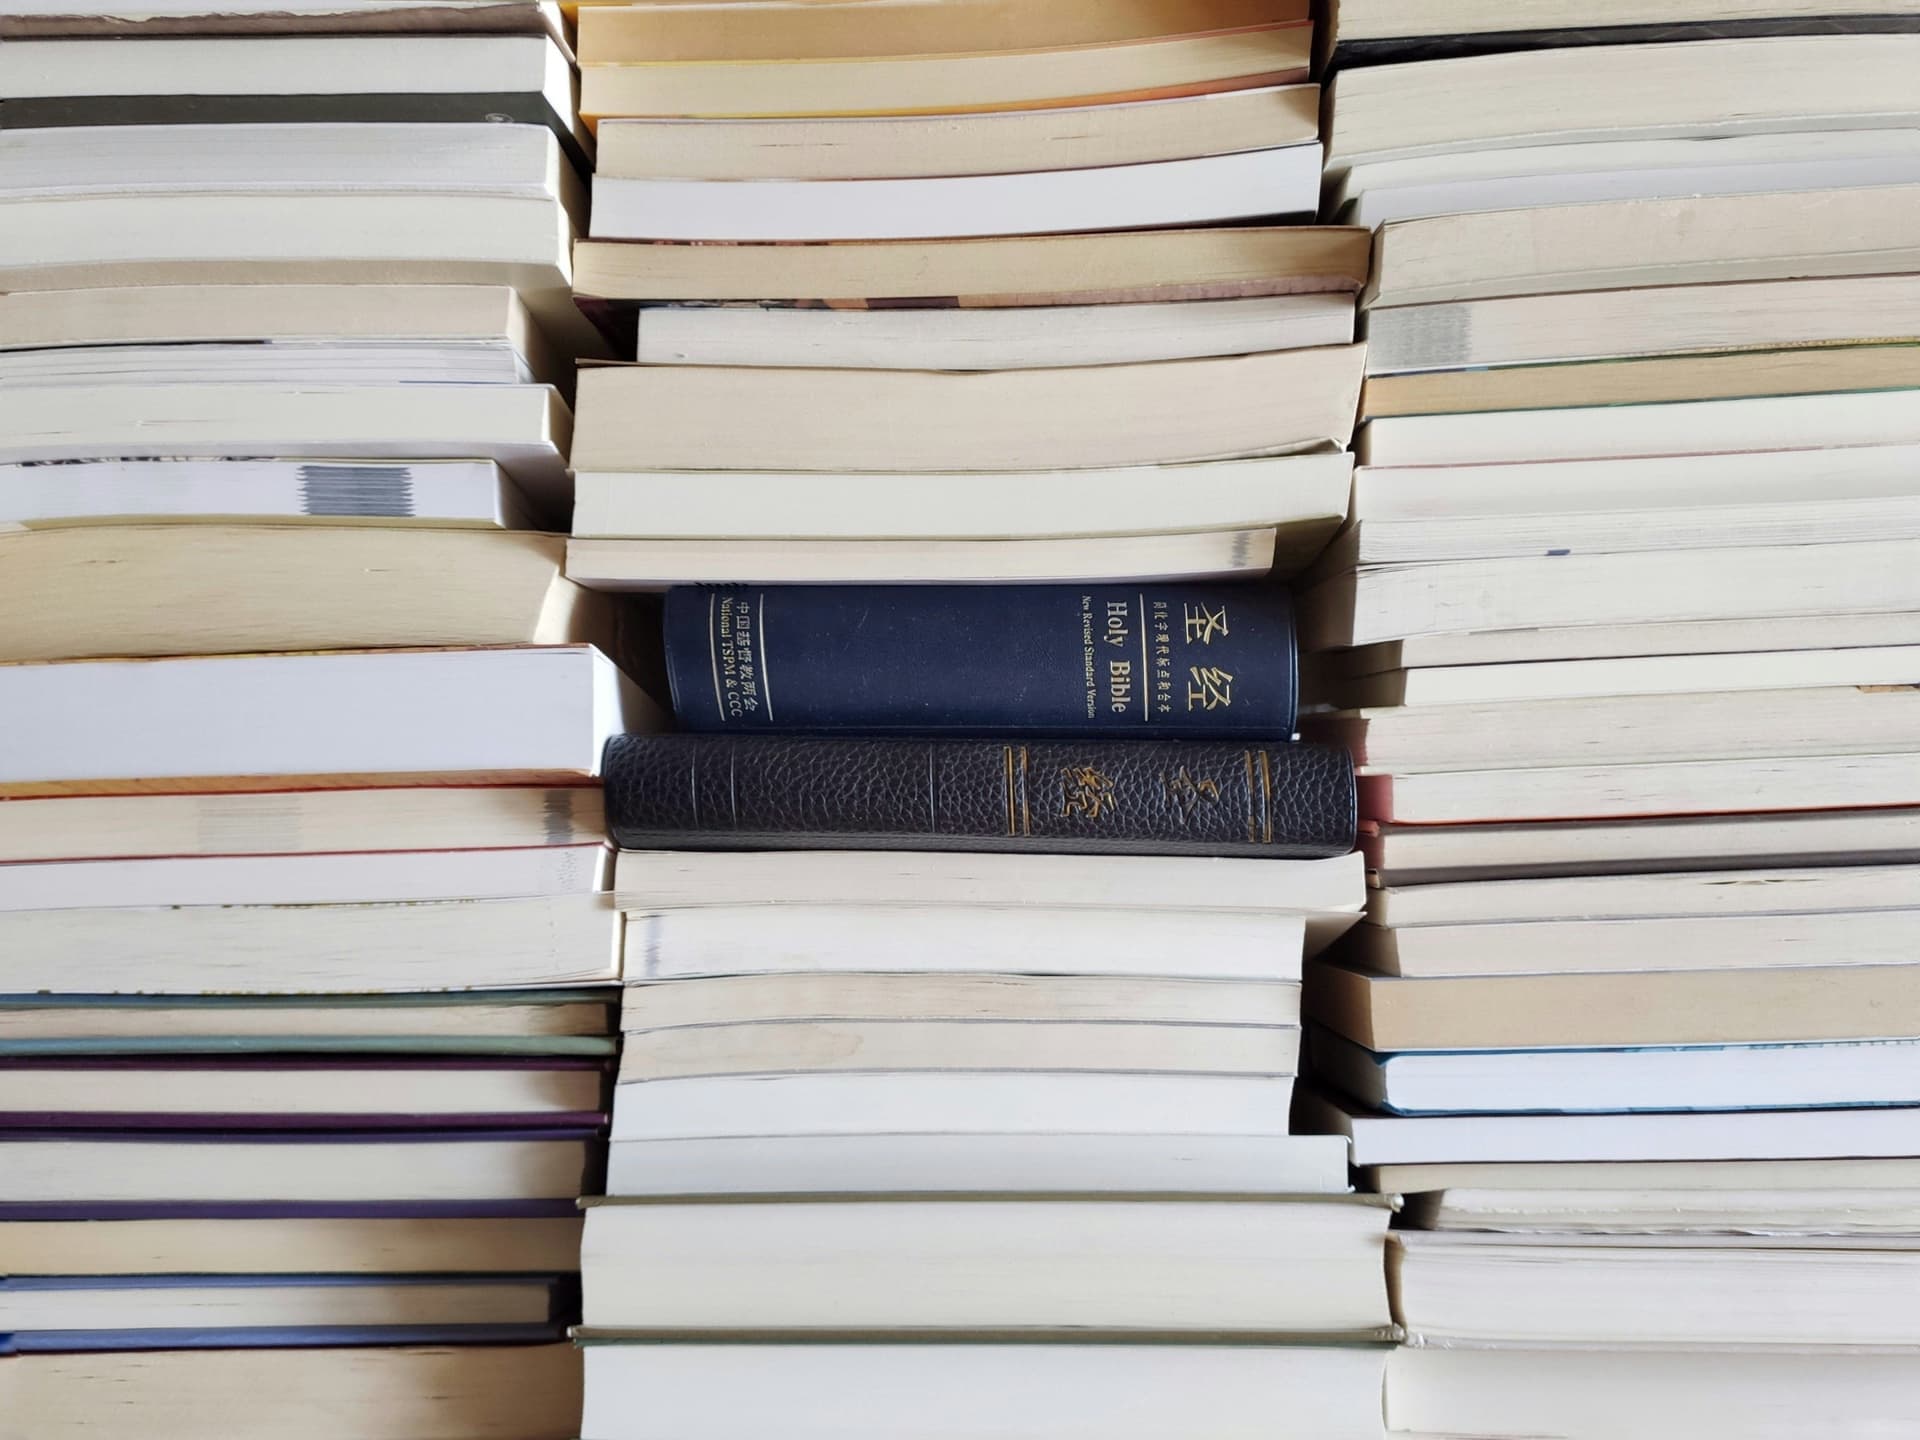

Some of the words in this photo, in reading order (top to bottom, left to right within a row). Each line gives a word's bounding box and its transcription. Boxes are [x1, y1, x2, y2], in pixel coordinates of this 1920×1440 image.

[720, 596, 735, 638] National
[1082, 595, 1093, 611] New
[1082, 612, 1095, 645] Revised
[1103, 601, 1129, 647] Holy
[722, 640, 737, 676] TSPM
[736, 601, 759, 711] 中国基督教两会
[1084, 646, 1096, 687] Standard
[1183, 601, 1233, 711] 圣经
[726, 679, 738, 689] &
[1110, 660, 1132, 713] Bible
[727, 691, 743, 718] CCC
[1086, 688, 1097, 719] Version
